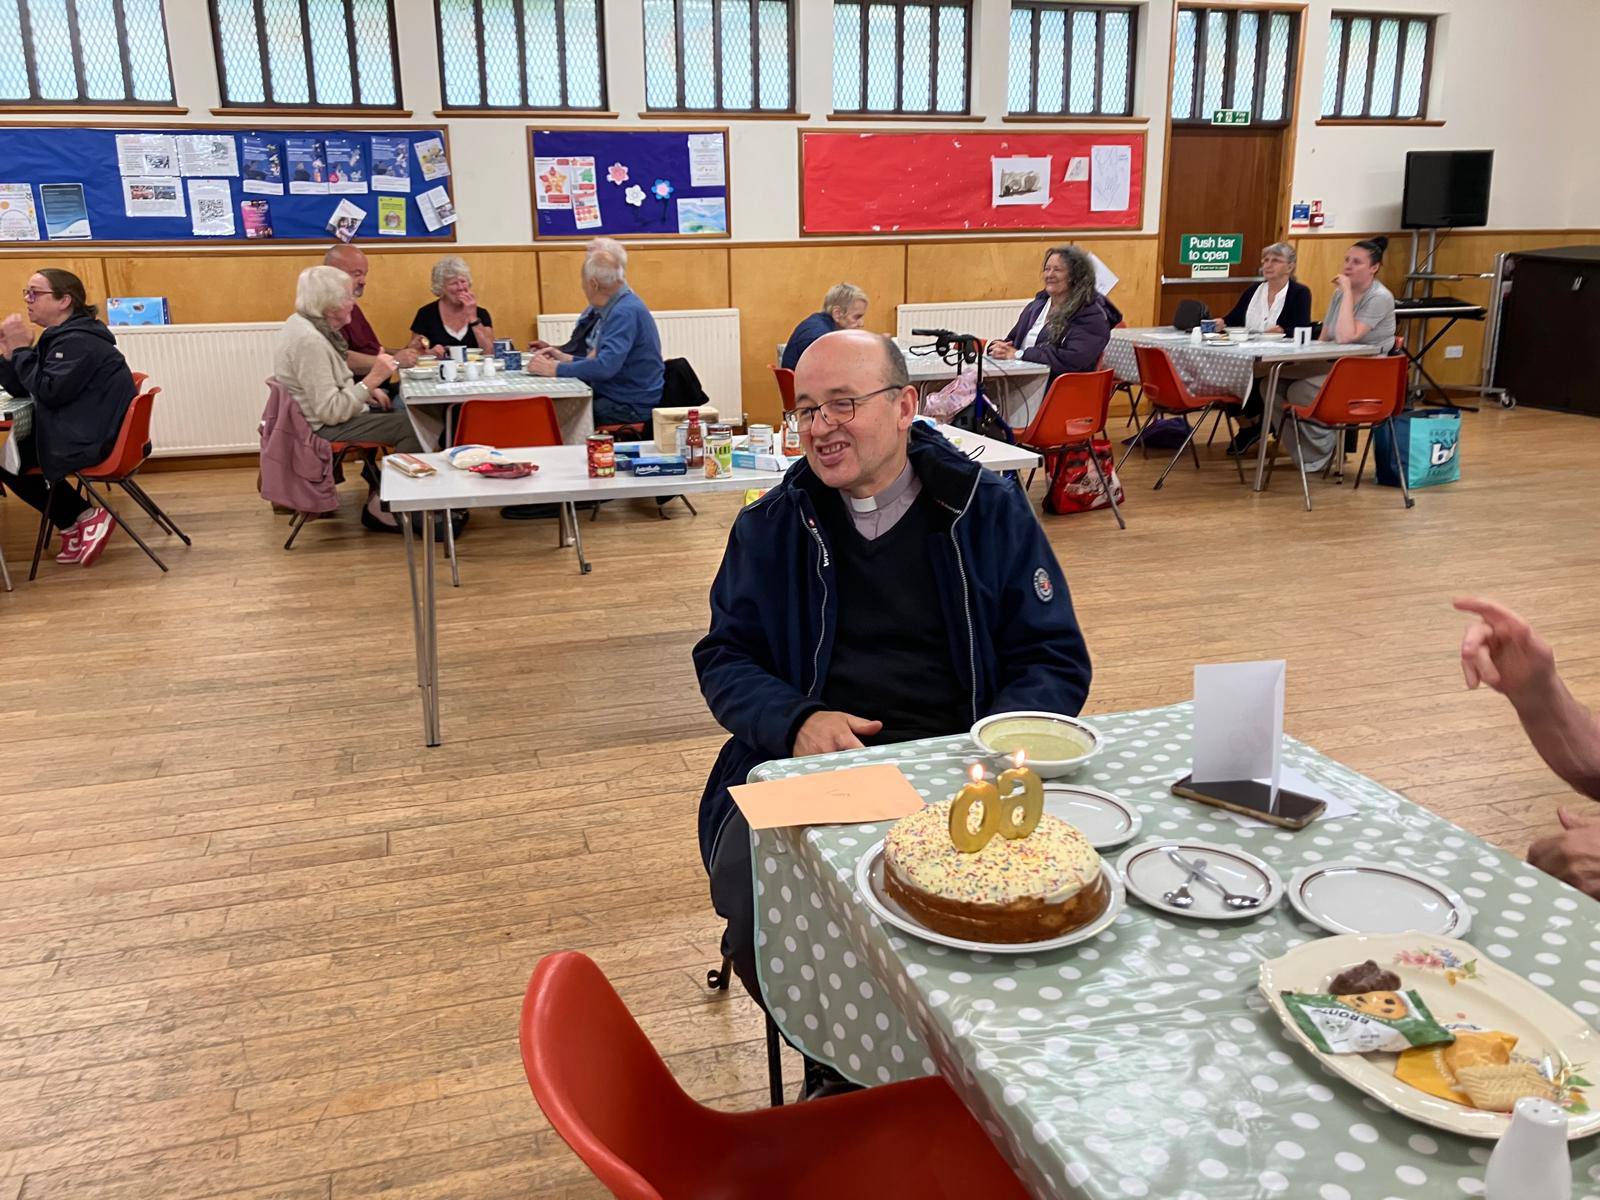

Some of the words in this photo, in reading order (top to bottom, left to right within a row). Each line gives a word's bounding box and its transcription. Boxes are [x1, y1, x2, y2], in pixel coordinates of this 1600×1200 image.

[1189, 236, 1216, 248] Push
[1217, 236, 1236, 248] bar
[1188, 250, 1200, 260] to
[1202, 250, 1229, 262] open
